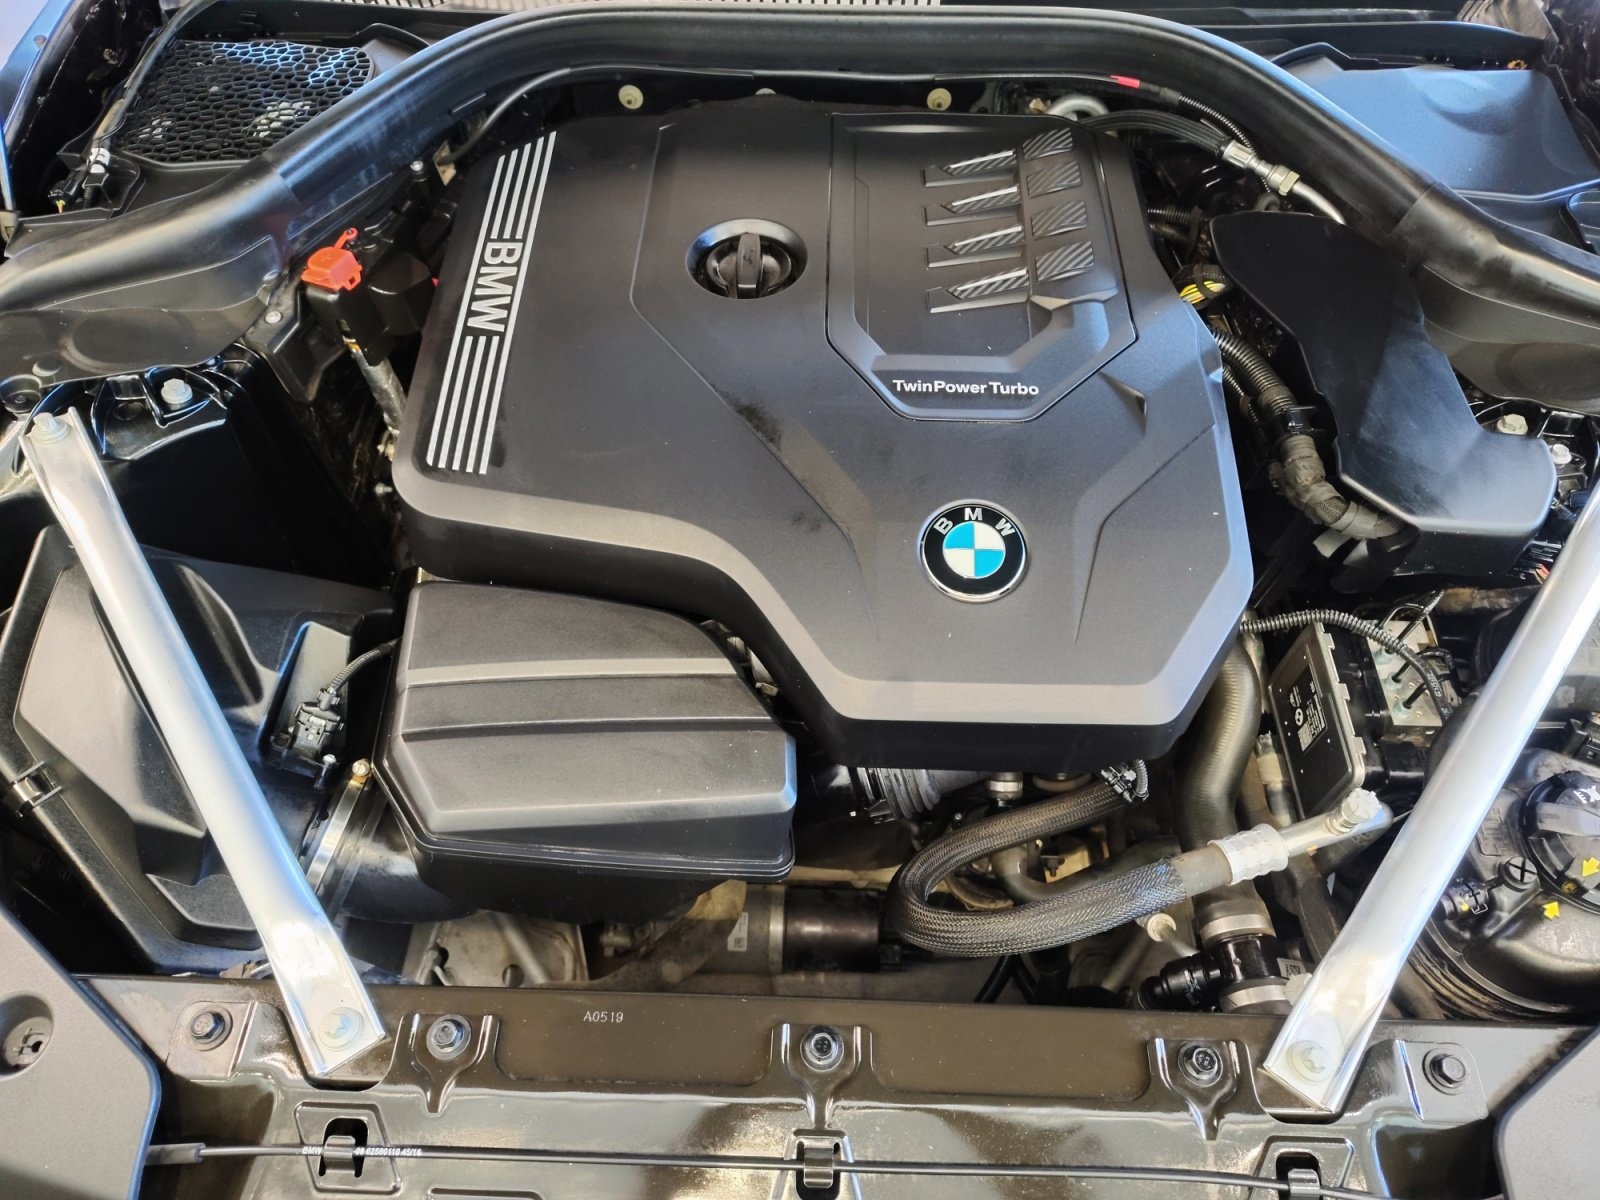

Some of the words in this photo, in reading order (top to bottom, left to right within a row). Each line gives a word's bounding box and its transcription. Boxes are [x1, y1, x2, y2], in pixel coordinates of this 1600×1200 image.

[467, 242, 523, 332] BMW
[989, 381, 1040, 395] Turbo
[933, 507, 1016, 537] BMW
[583, 1010, 624, 1023] A0519
[302, 1146, 323, 1156] BMW
